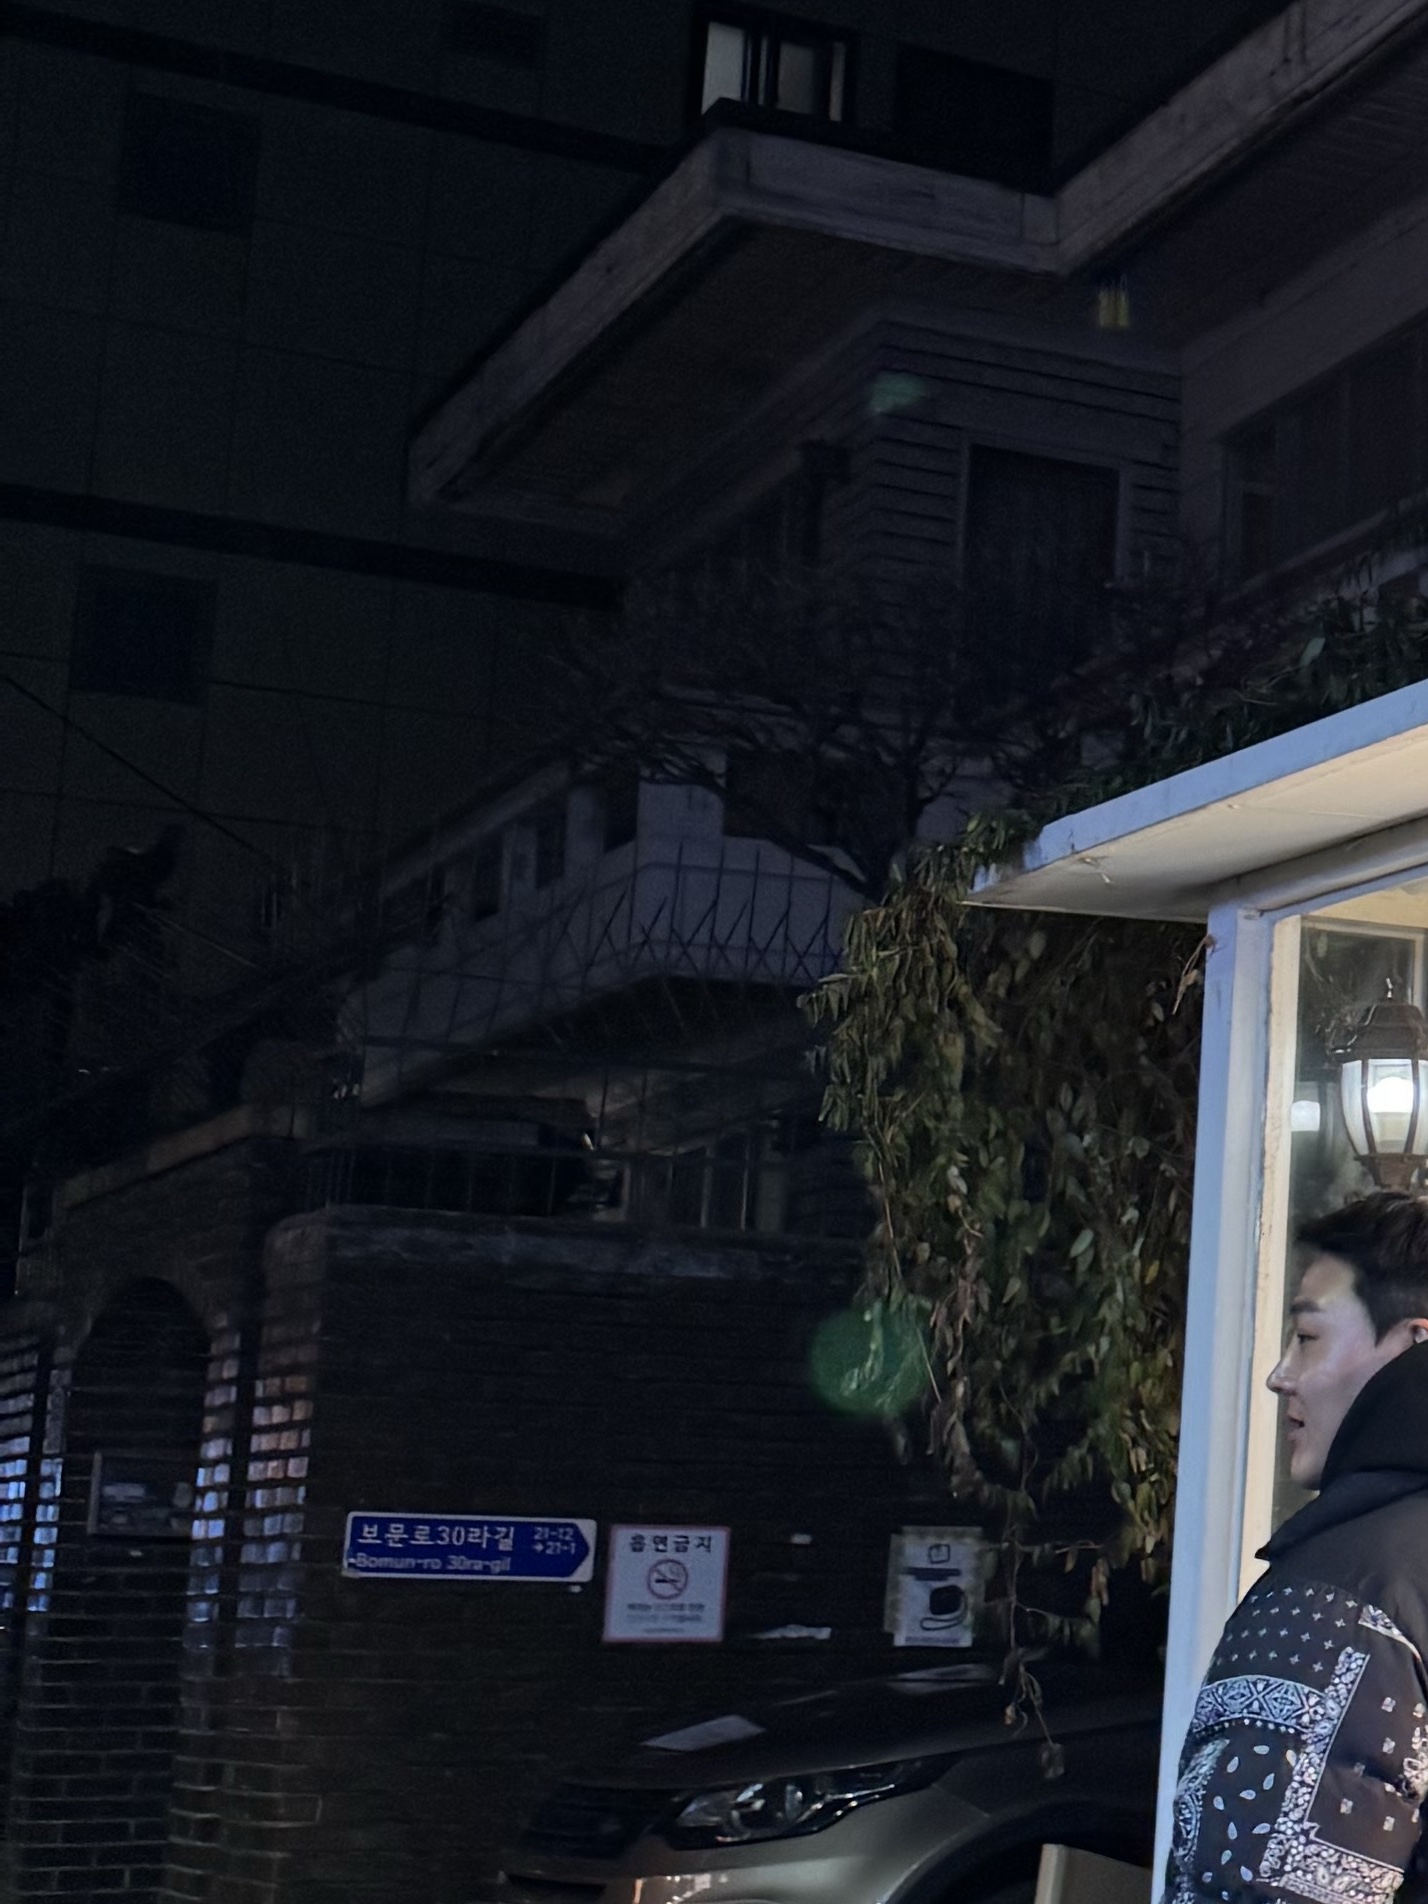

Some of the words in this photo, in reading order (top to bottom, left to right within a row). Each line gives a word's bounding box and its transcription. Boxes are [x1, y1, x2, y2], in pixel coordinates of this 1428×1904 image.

[356, 1522, 515, 1552] 보문로30라길
[355, 1552, 443, 1570] Bomun-ro
[445, 1554, 512, 1574] 30ra-gil
